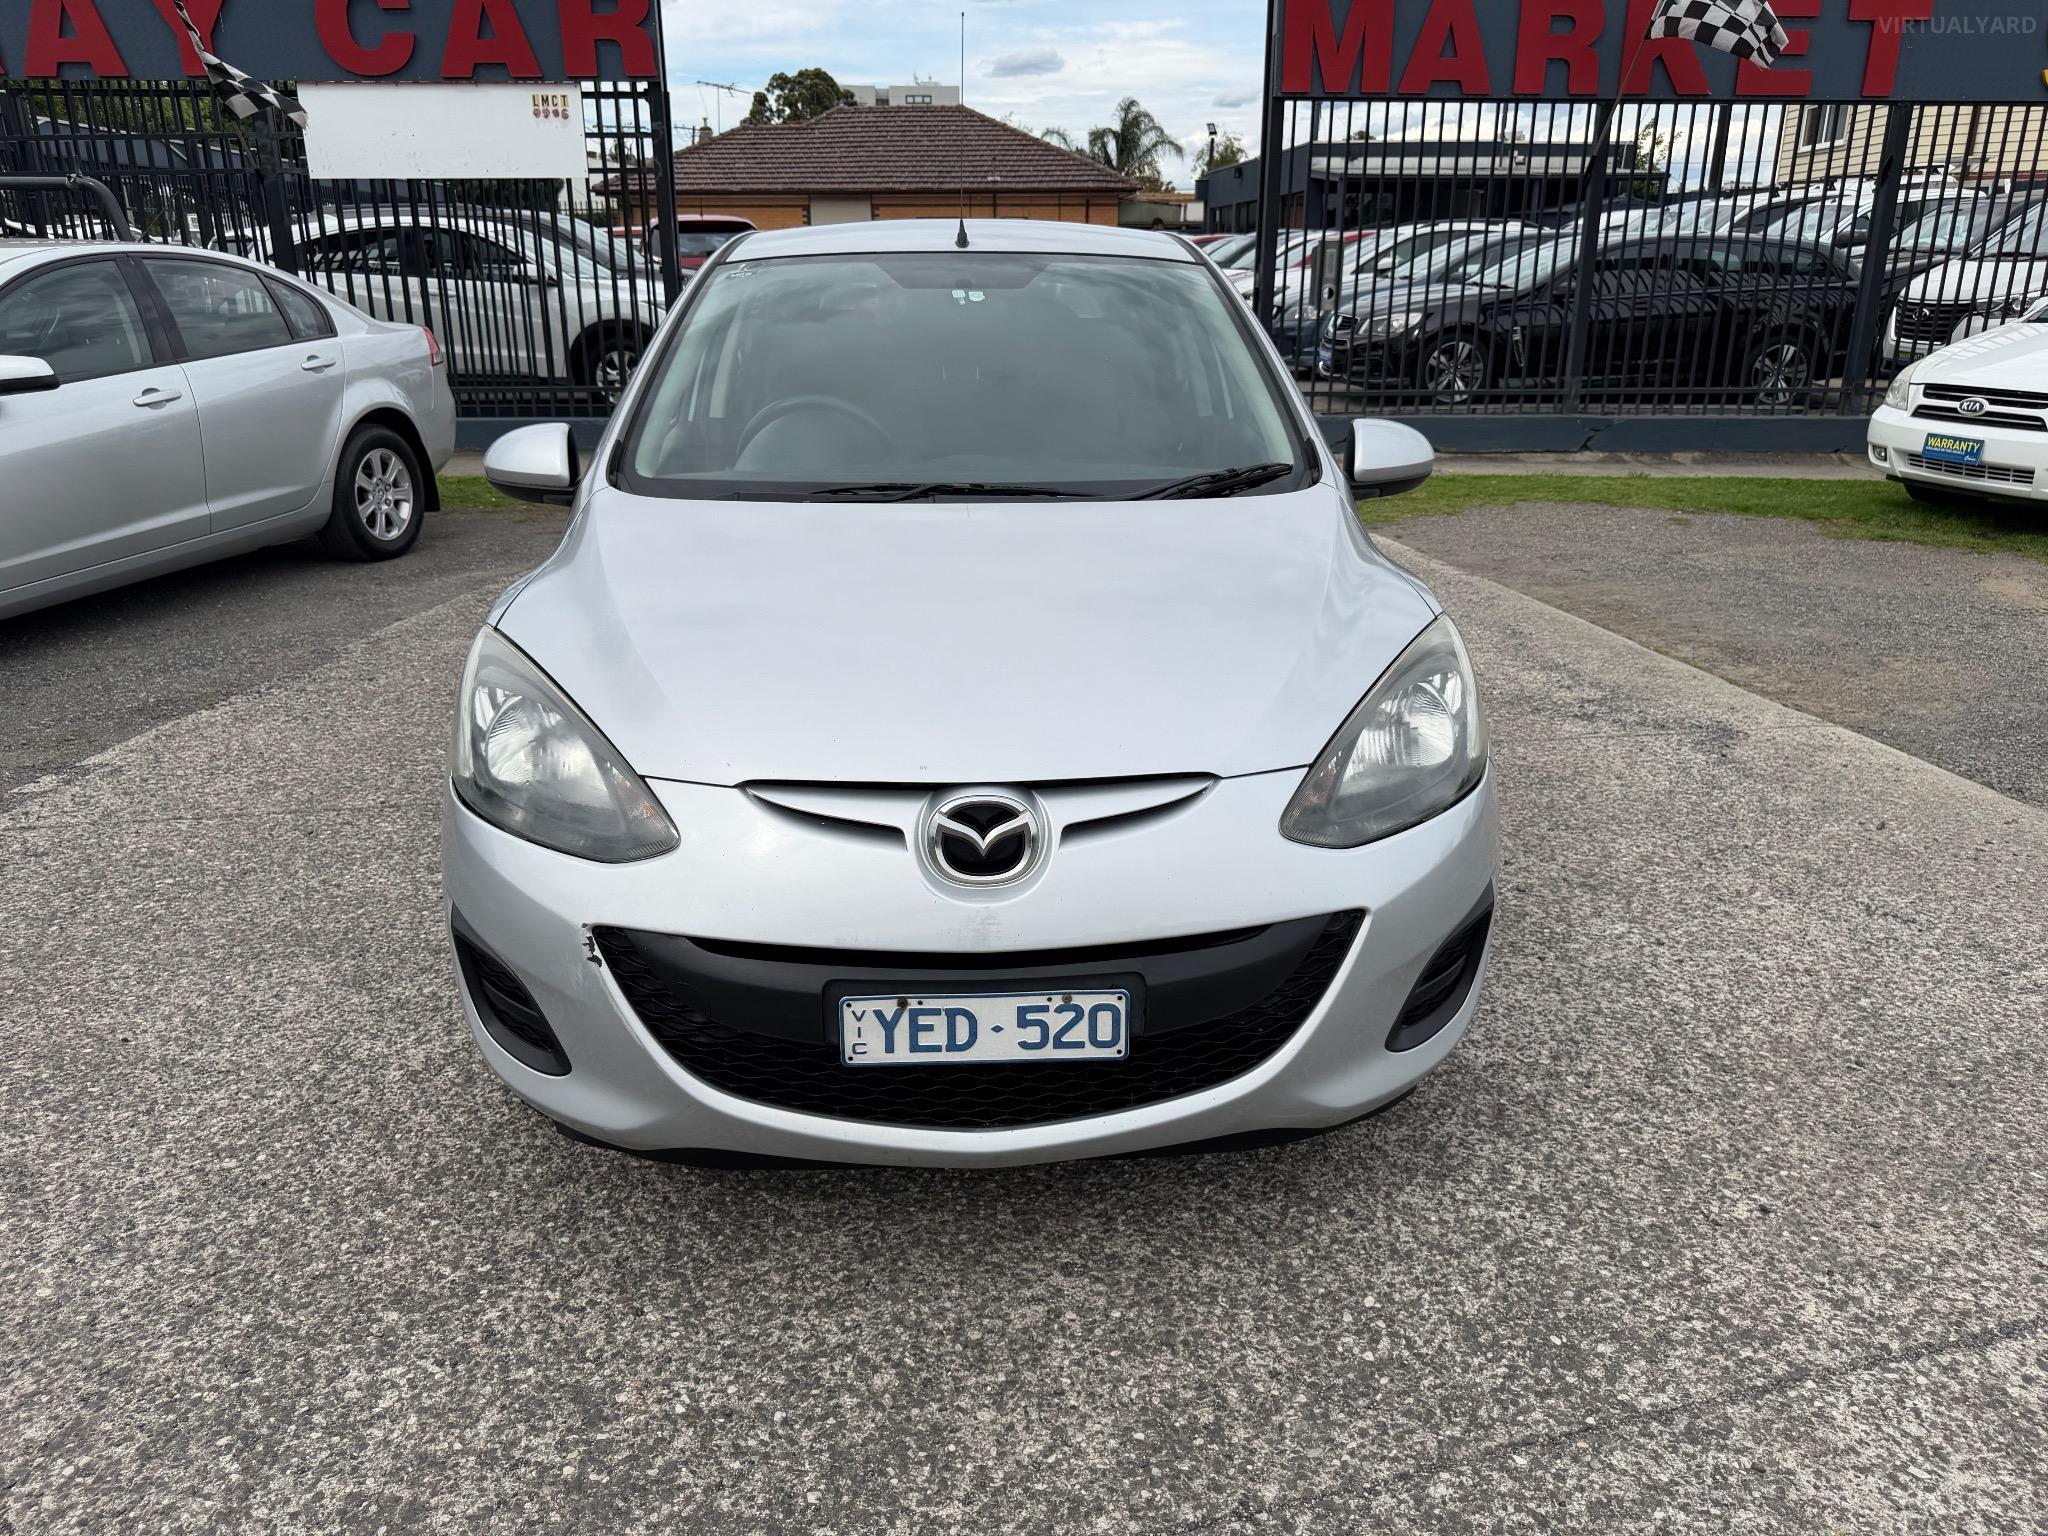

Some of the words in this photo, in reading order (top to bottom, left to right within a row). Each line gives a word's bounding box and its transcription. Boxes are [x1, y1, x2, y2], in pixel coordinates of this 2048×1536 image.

[0, 0, 222, 77] AY
[313, 0, 657, 77] CAR
[1282, 0, 1935, 96] MARKET
[532, 94, 568, 107] LMCT
[1961, 401, 1981, 411] KIA
[1927, 436, 1981, 453] WARRANTY
[851, 1009, 868, 1055] VIC
[872, 1006, 978, 1054] YED
[1016, 1002, 1121, 1051] 520
